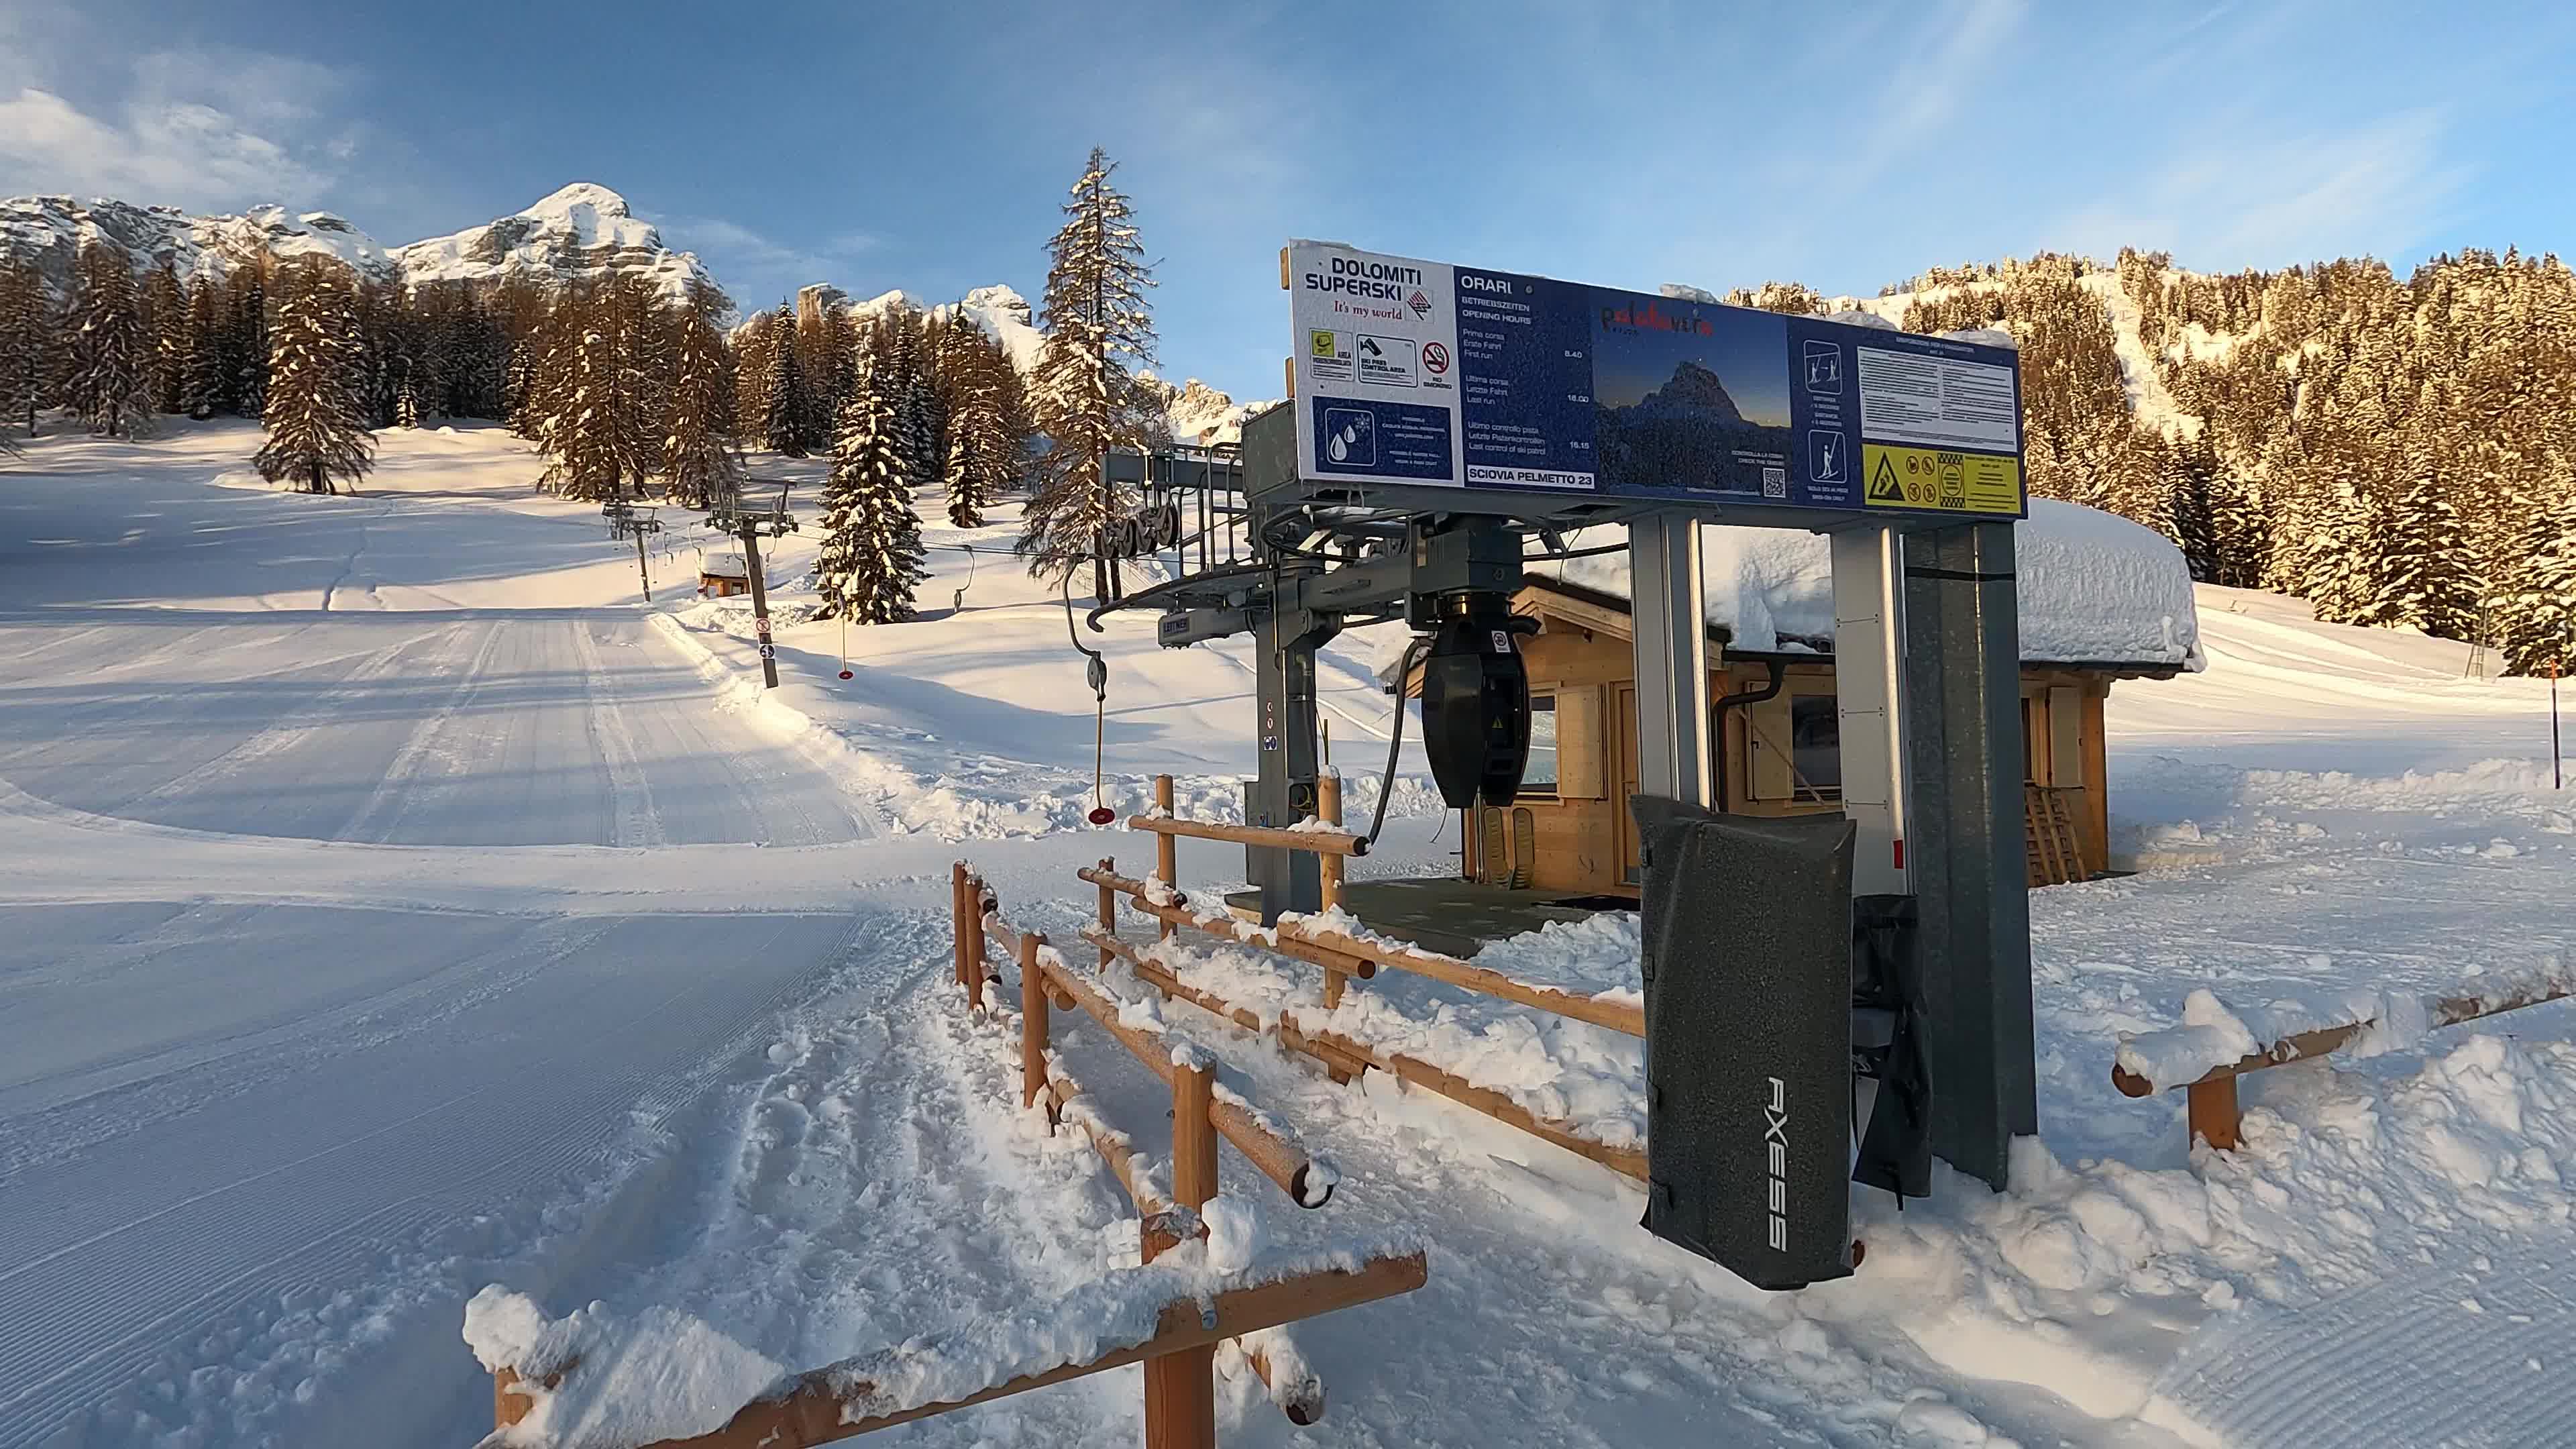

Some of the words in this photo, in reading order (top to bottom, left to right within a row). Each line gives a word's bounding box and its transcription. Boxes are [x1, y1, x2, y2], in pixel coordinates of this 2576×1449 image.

[1332, 258, 1421, 285] DOLOMITI
[1305, 273, 1401, 301] SUPERSKI
[1461, 276, 1513, 294] ORARI
[1334, 301, 1349, 313] It's
[1352, 306, 1369, 319] my
[1371, 307, 1403, 320] world
[1462, 296, 1530, 312] BETRIEBSZEITEN
[1462, 309, 1500, 321] OPENING
[1502, 315, 1532, 325] HOURS
[1463, 329, 1483, 338] Prima
[1361, 364, 1390, 372] CONTROL
[1469, 468, 1515, 481] SCIOVIA
[1517, 472, 1576, 484] PELMETTO
[1578, 476, 1592, 485] 23
[1764, 1076, 1788, 1252] AXESS
